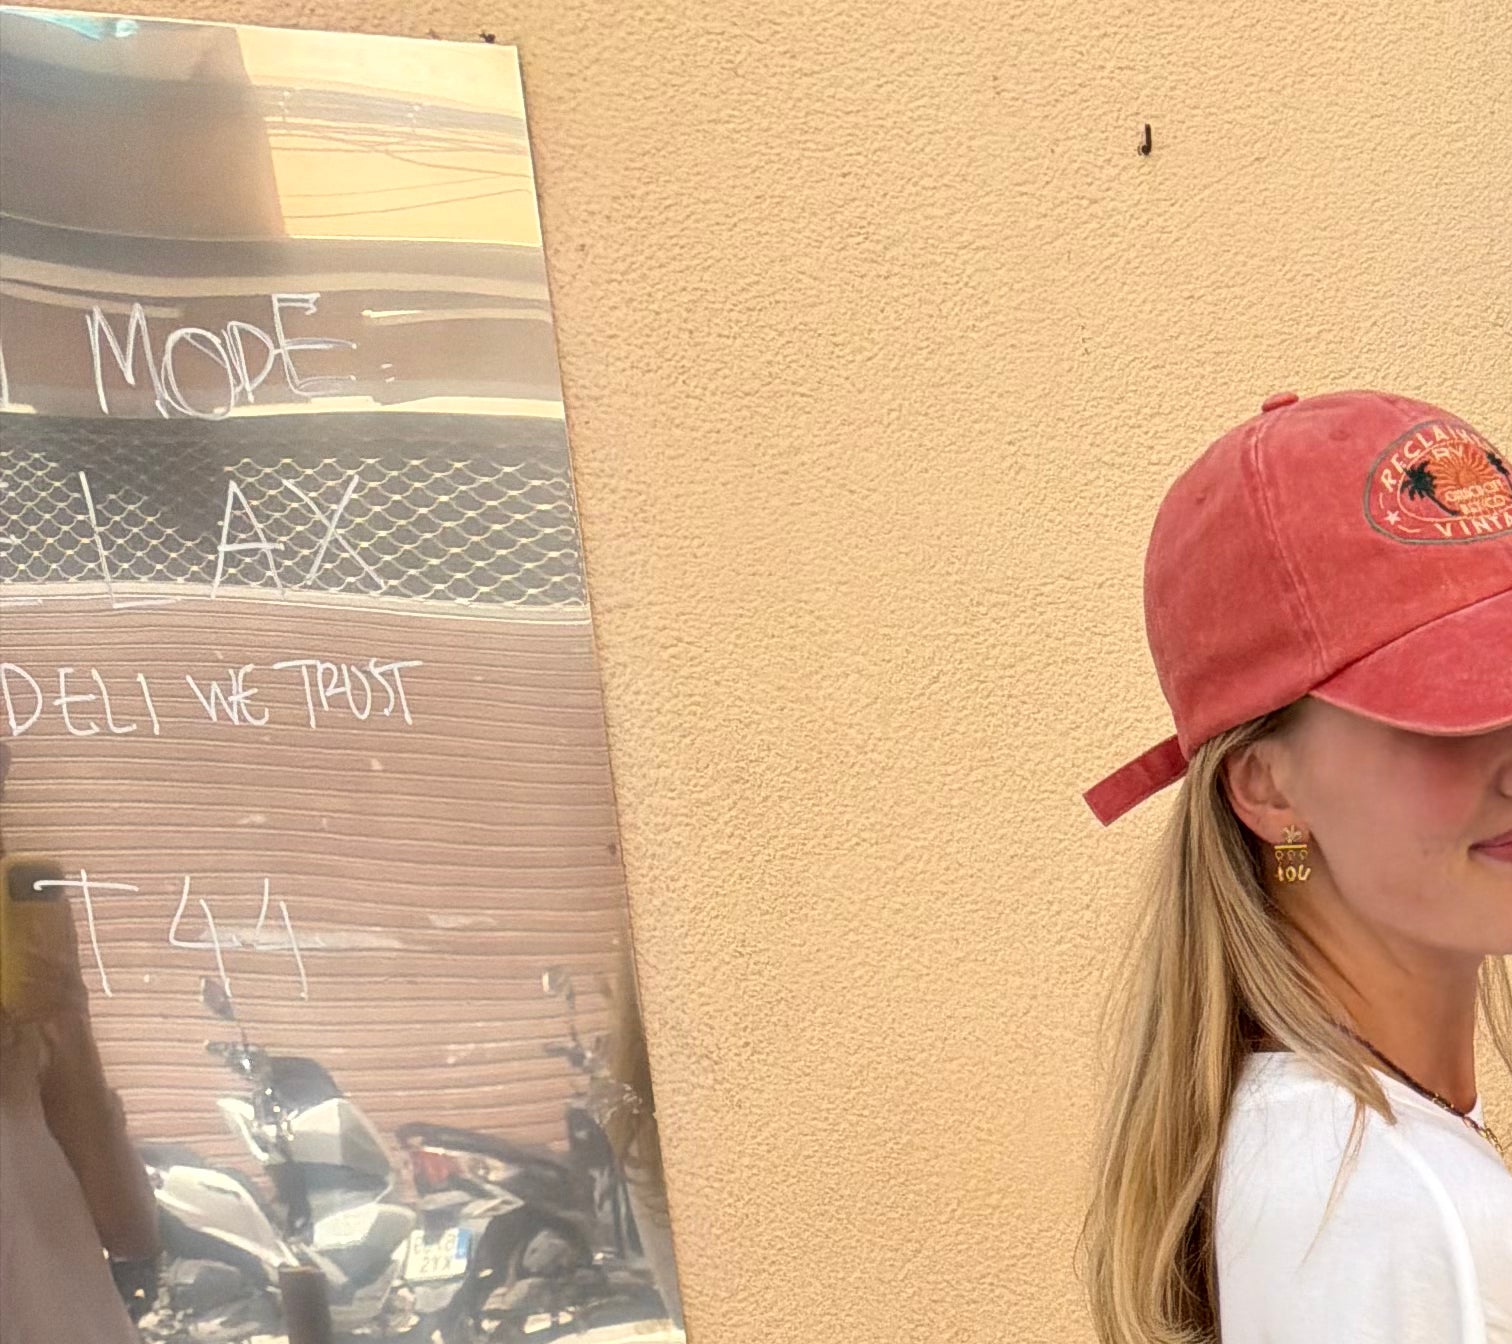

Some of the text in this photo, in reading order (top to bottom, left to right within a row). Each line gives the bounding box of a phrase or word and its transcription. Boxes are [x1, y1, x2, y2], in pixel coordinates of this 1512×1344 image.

[0, 658, 424, 736] DELI WE TRUST
